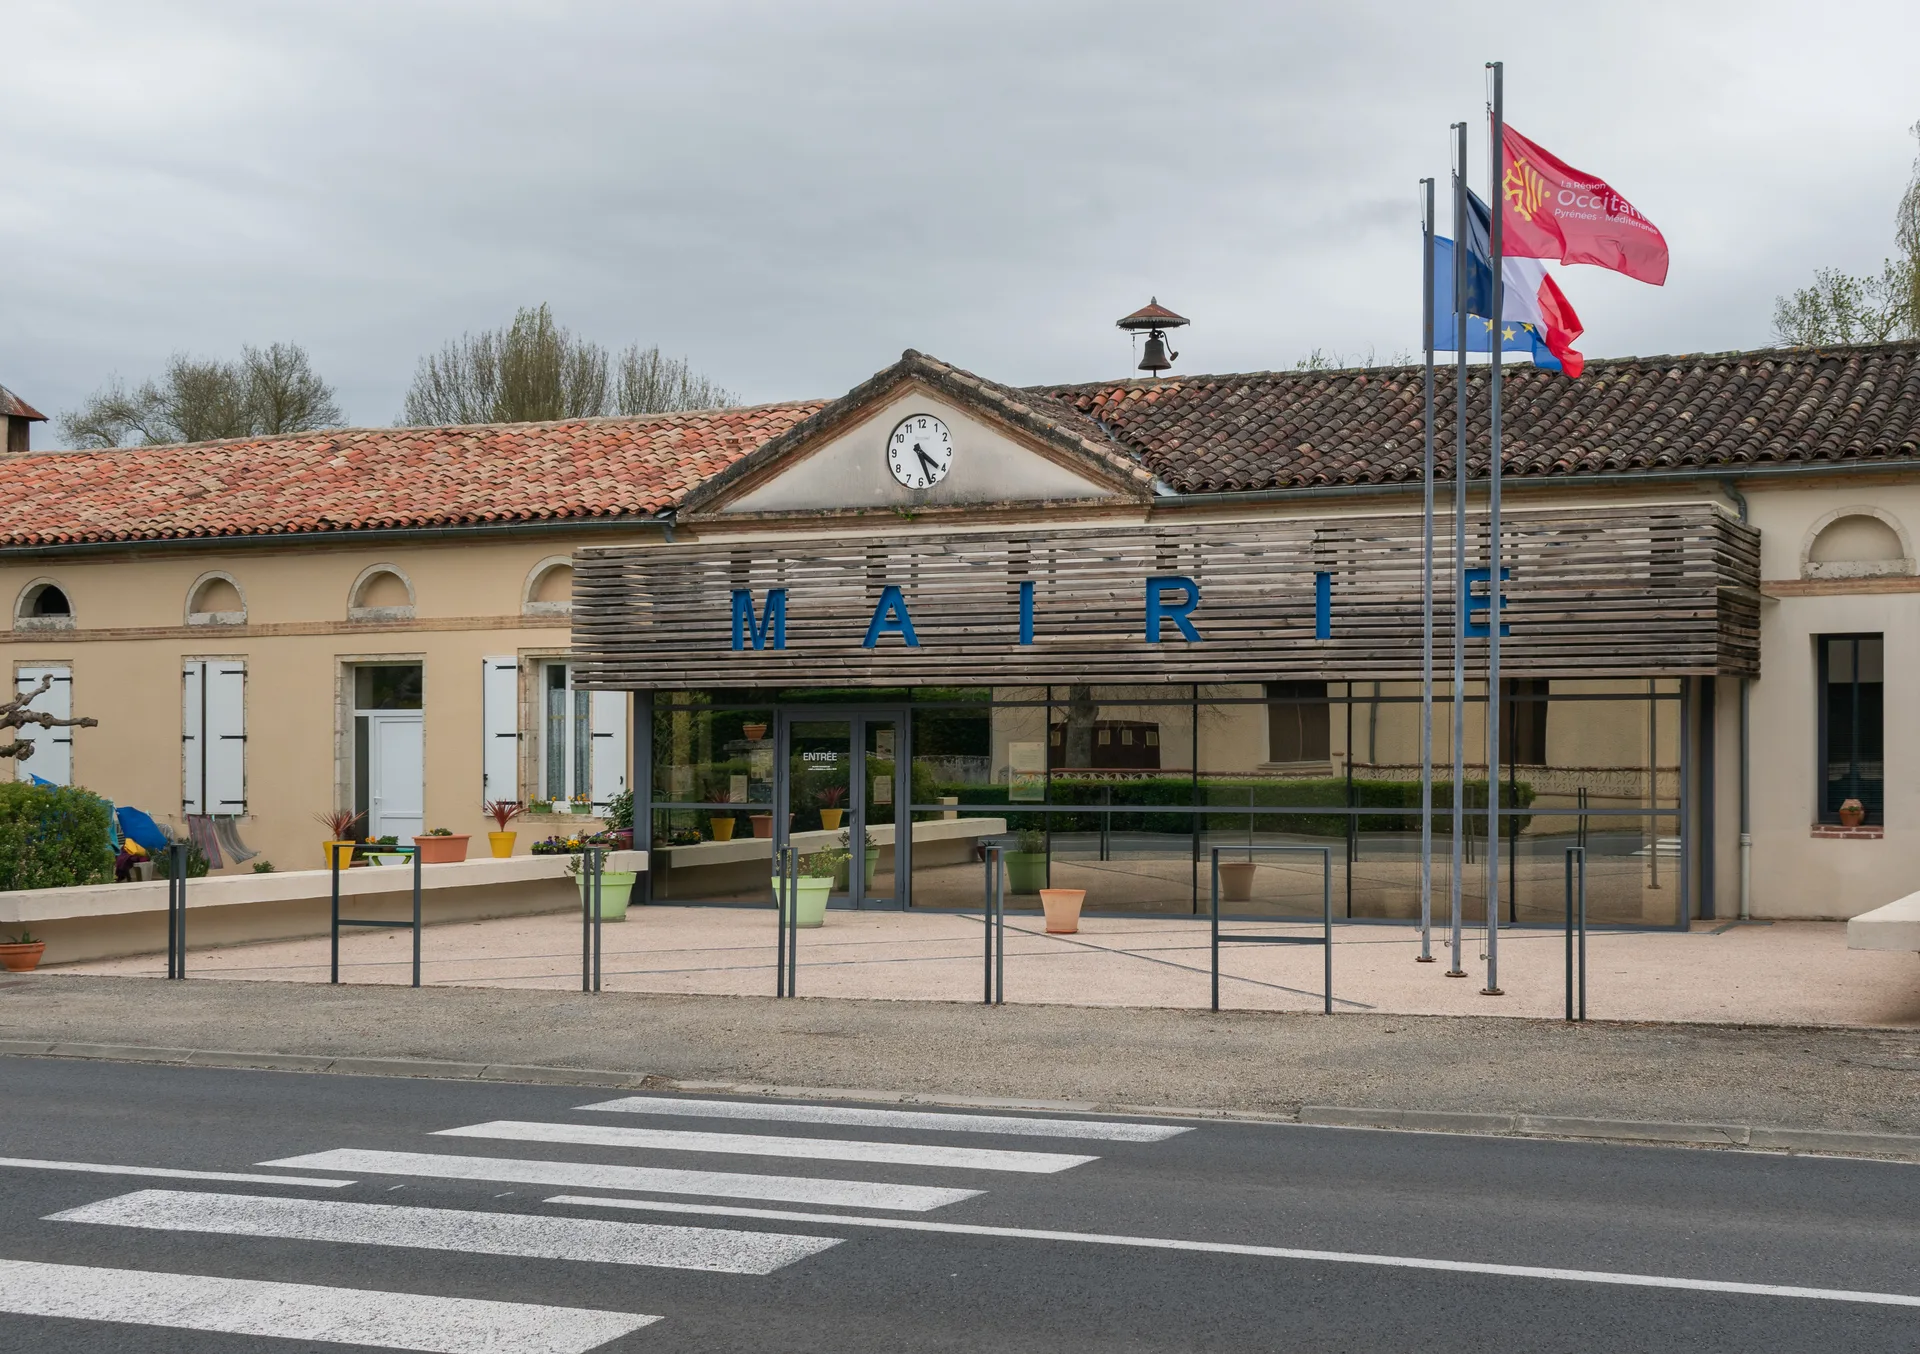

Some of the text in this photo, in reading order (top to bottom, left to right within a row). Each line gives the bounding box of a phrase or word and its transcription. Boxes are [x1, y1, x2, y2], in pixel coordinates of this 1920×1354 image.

[1560, 180, 1606, 192] La Région
[1554, 208, 1597, 221] Pyrénées
[905, 424, 912, 433] 11
[917, 419, 927, 428] 12
[934, 423, 938, 432] 1
[895, 433, 905, 443] 10
[942, 432, 948, 442] 2
[891, 449, 897, 458] 9
[946, 447, 952, 457] 3
[895, 464, 901, 473] 8
[941, 463, 946, 472] 4
[906, 474, 911, 483] 7
[918, 477, 924, 487] 6
[931, 473, 936, 483] 5
[731, 567, 1510, 651] MAIRIE
[803, 750, 838, 761] ENTRÉE
